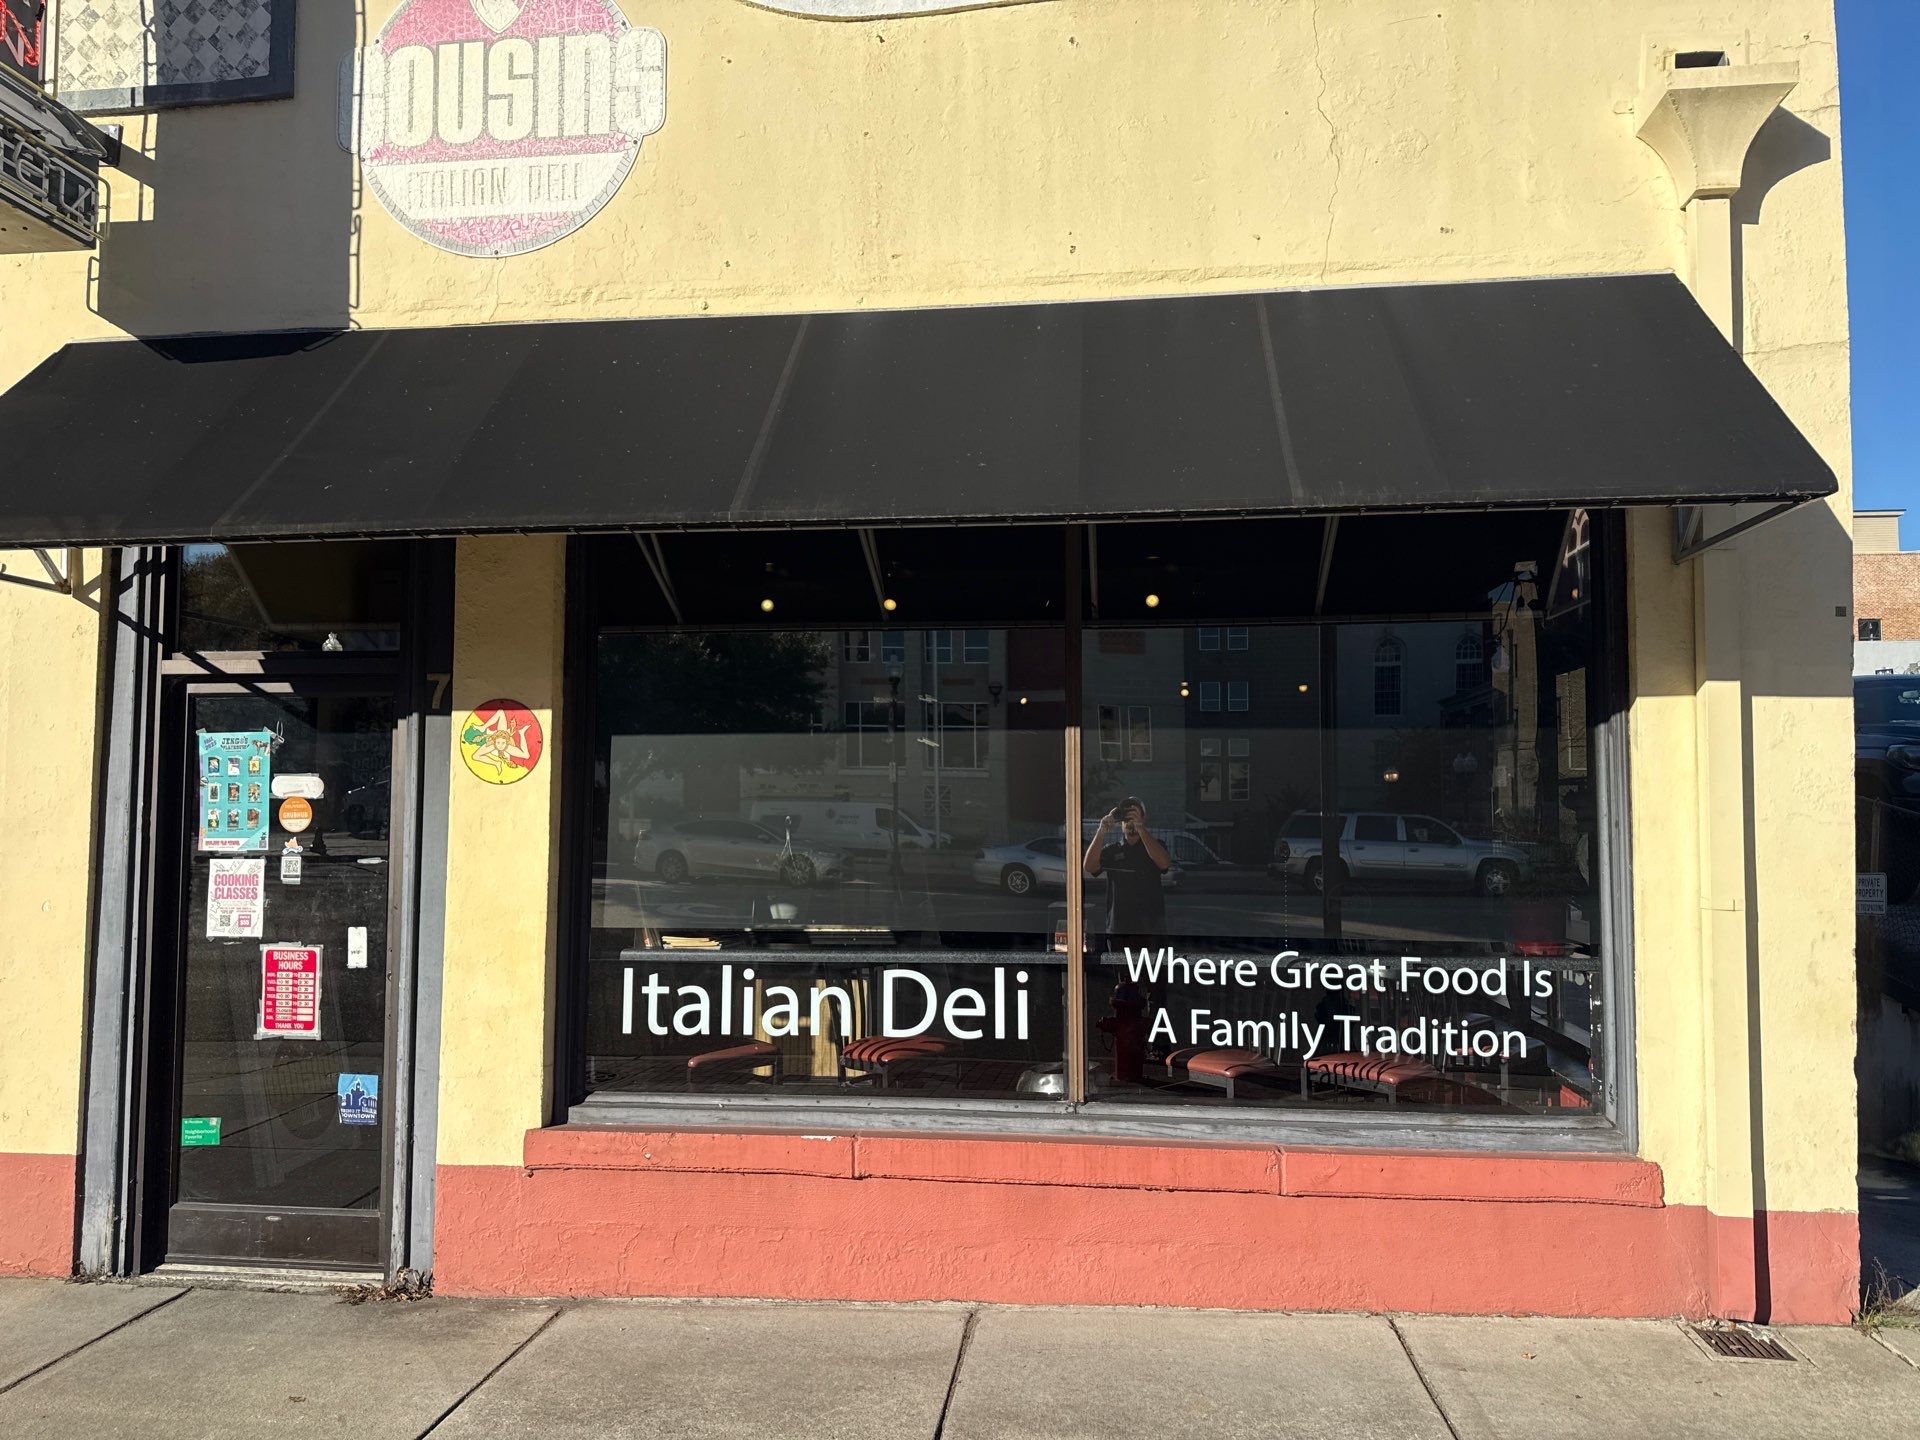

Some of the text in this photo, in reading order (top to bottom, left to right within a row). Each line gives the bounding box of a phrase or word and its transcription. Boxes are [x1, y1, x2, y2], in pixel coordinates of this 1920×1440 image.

[408, 162, 582, 210] ITALIAN DELI
[427, 673, 451, 710] 7
[282, 811, 309, 819] GRUBHUB
[214, 873, 259, 887] COOKING
[1858, 878, 1881, 887] PRIVATE
[214, 886, 258, 900] CLASSES
[273, 951, 309, 961] BUSINESS
[278, 961, 304, 970] HOURS
[1125, 947, 1553, 997] Where Great Food Is
[622, 965, 1029, 1040] Italian Deli
[1149, 1008, 1527, 1060] A Family Tradition
